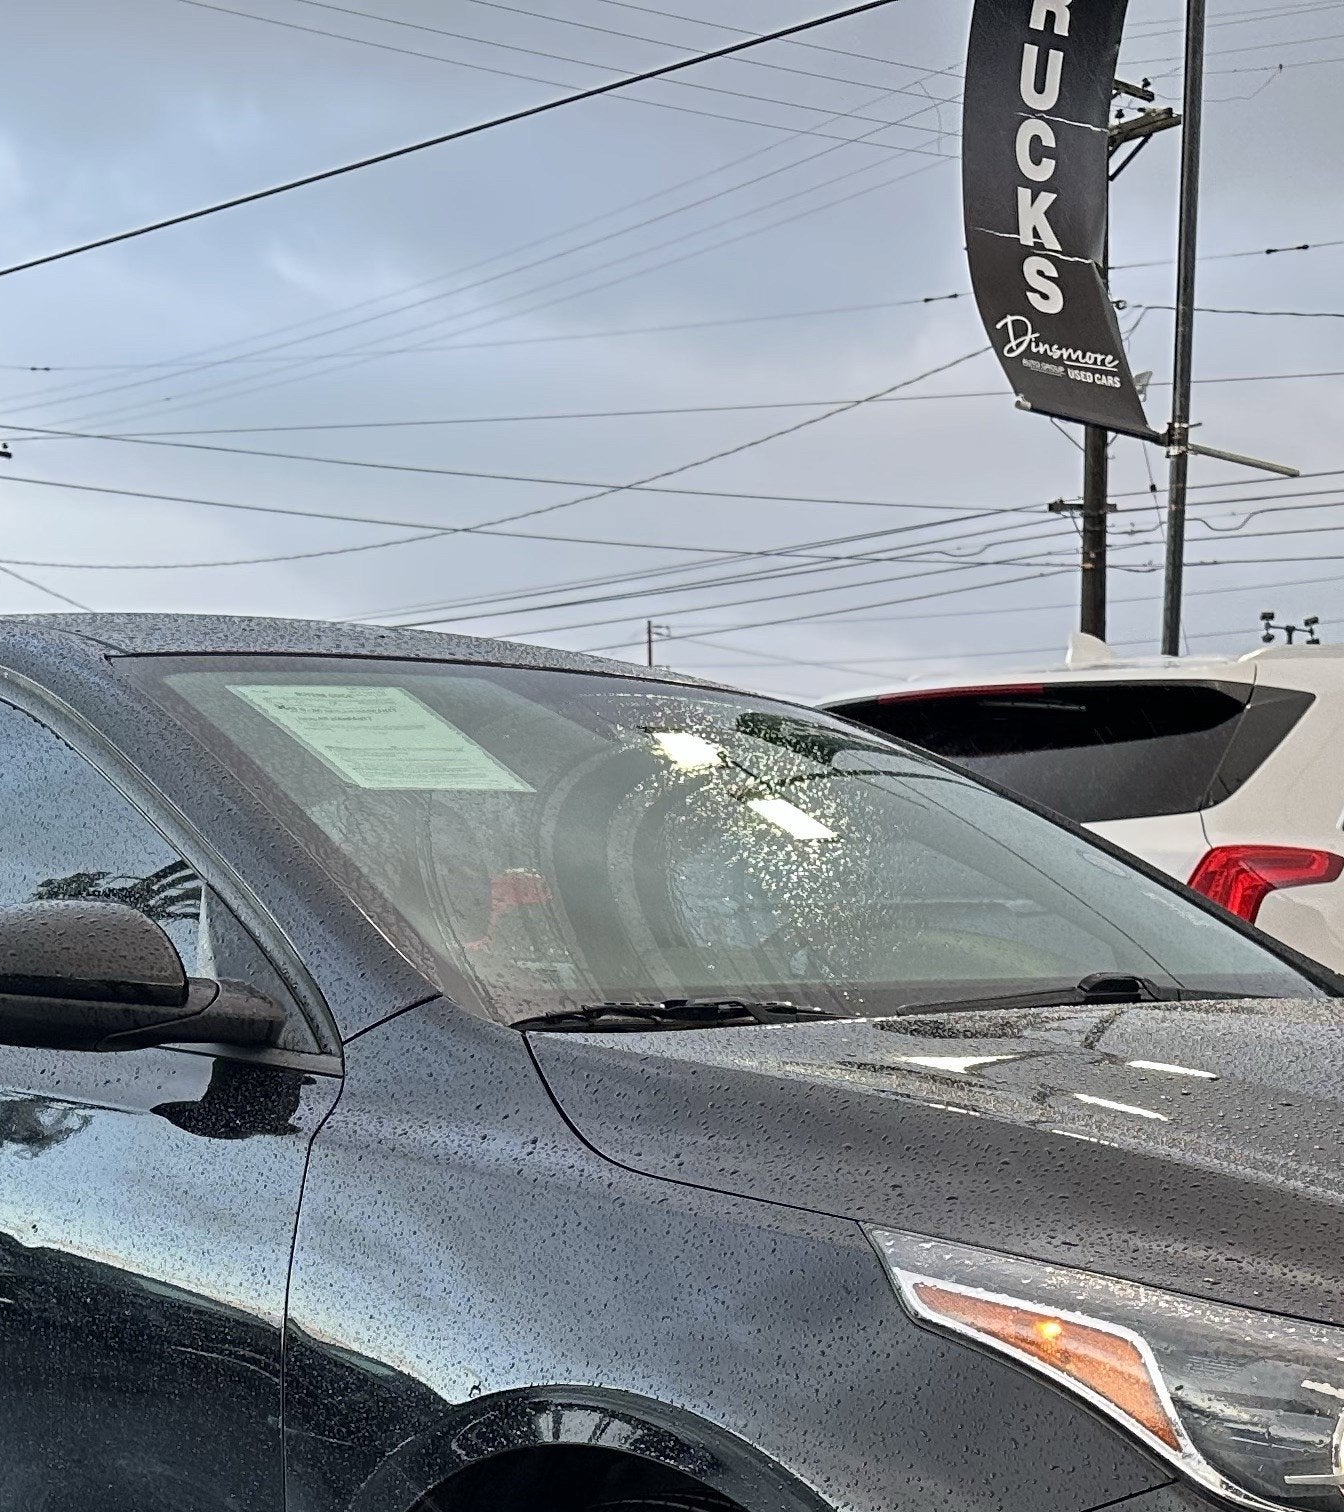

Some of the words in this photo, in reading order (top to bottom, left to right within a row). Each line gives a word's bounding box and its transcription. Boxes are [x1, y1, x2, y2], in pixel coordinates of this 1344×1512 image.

[996, 314, 1119, 368] Dinsmore
[1067, 368, 1094, 383] USED
[1094, 373, 1121, 388] CARS
